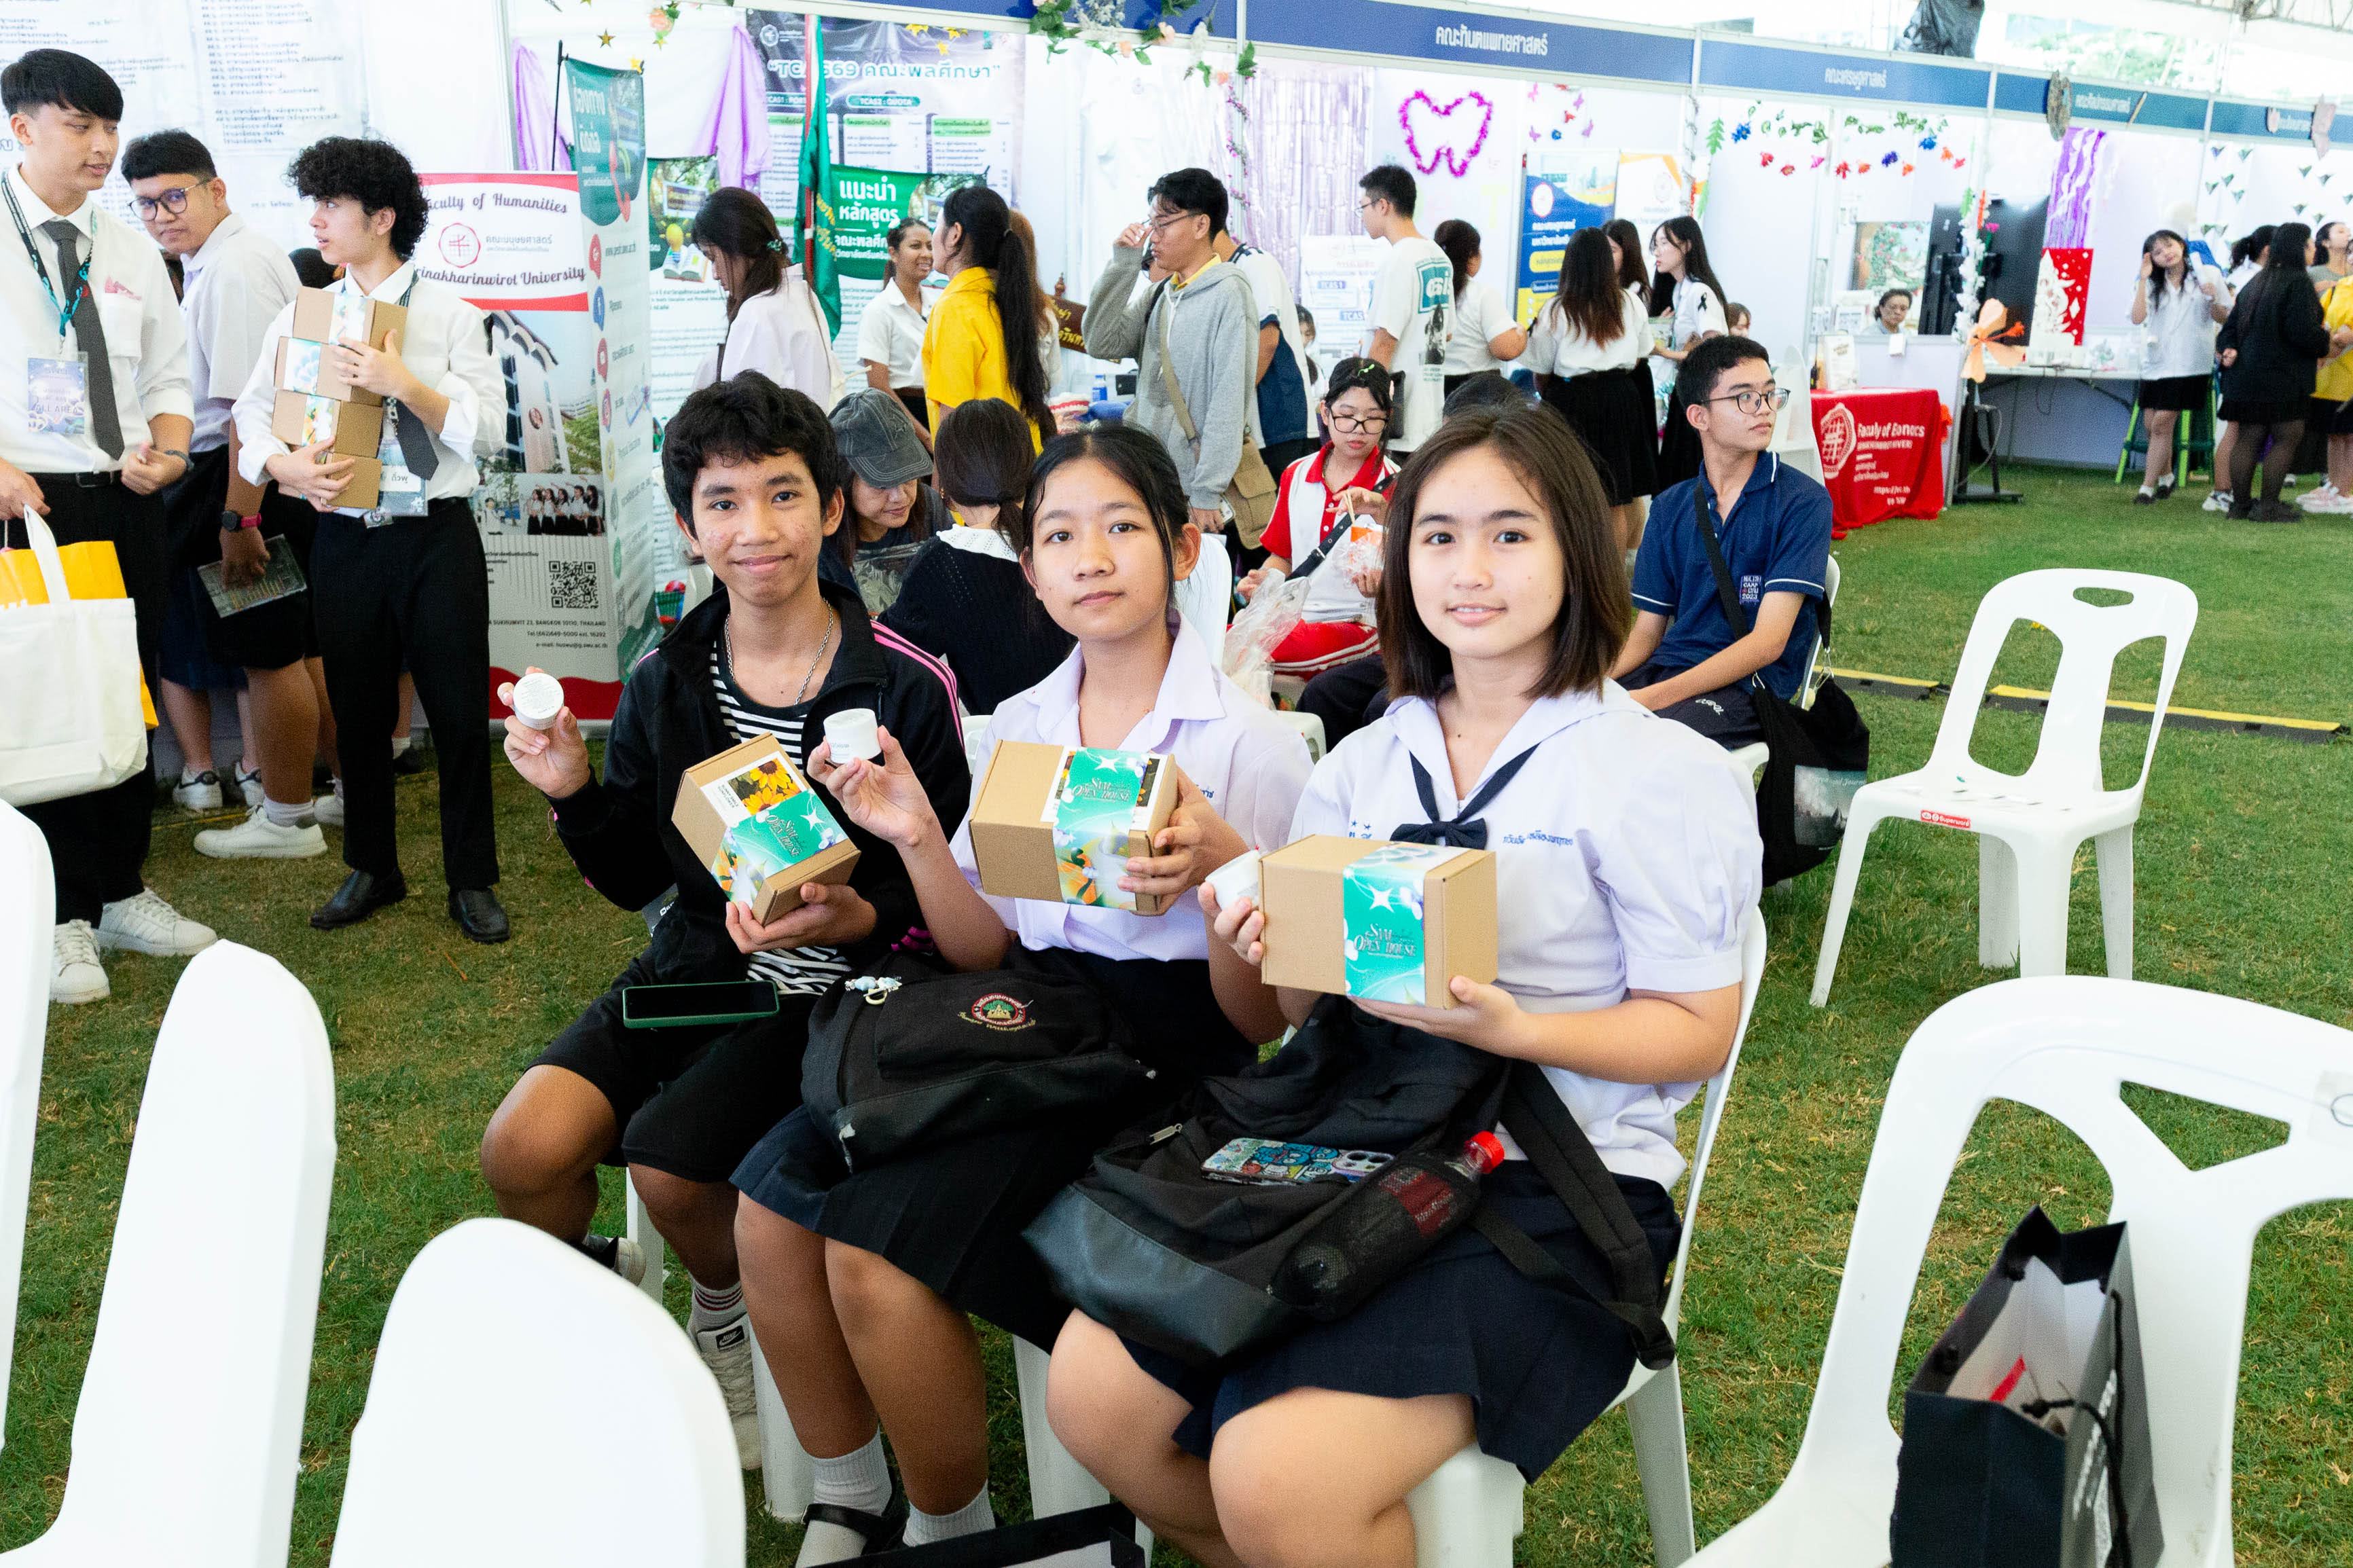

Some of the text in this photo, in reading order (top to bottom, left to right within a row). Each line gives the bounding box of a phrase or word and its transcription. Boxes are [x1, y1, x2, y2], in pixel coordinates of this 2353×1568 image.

[1435, 23, 1548, 56] คณะทันตแพทยศาสตร์
[839, 175, 897, 202] แนะนำ
[427, 193, 568, 213] aculty of Humanities
[839, 201, 901, 229] หลักสูตร
[416, 266, 586, 286] rinakharinwirot University
[722, 1331, 737, 1342] NIKE
